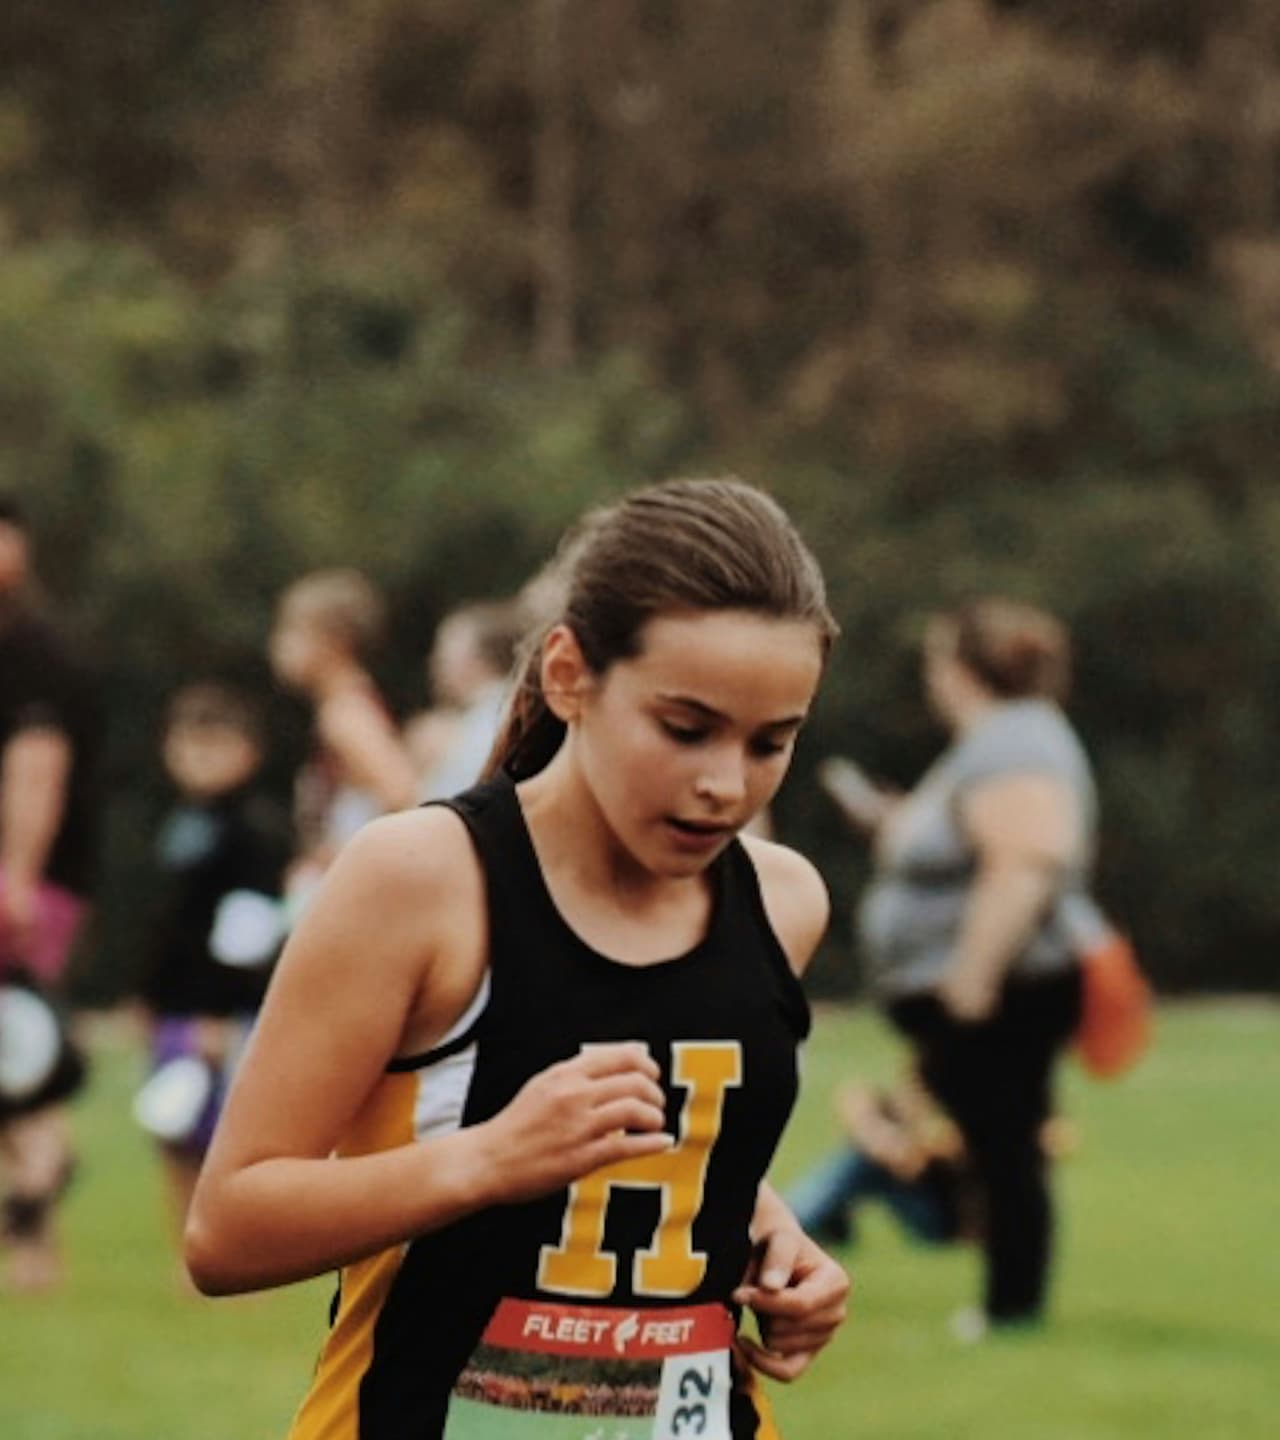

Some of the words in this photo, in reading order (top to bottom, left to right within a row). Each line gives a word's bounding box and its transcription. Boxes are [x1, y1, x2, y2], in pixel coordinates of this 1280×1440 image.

[536, 1040, 742, 1298] H
[522, 1313, 610, 1344] FLEET
[640, 1318, 695, 1346] FEET
